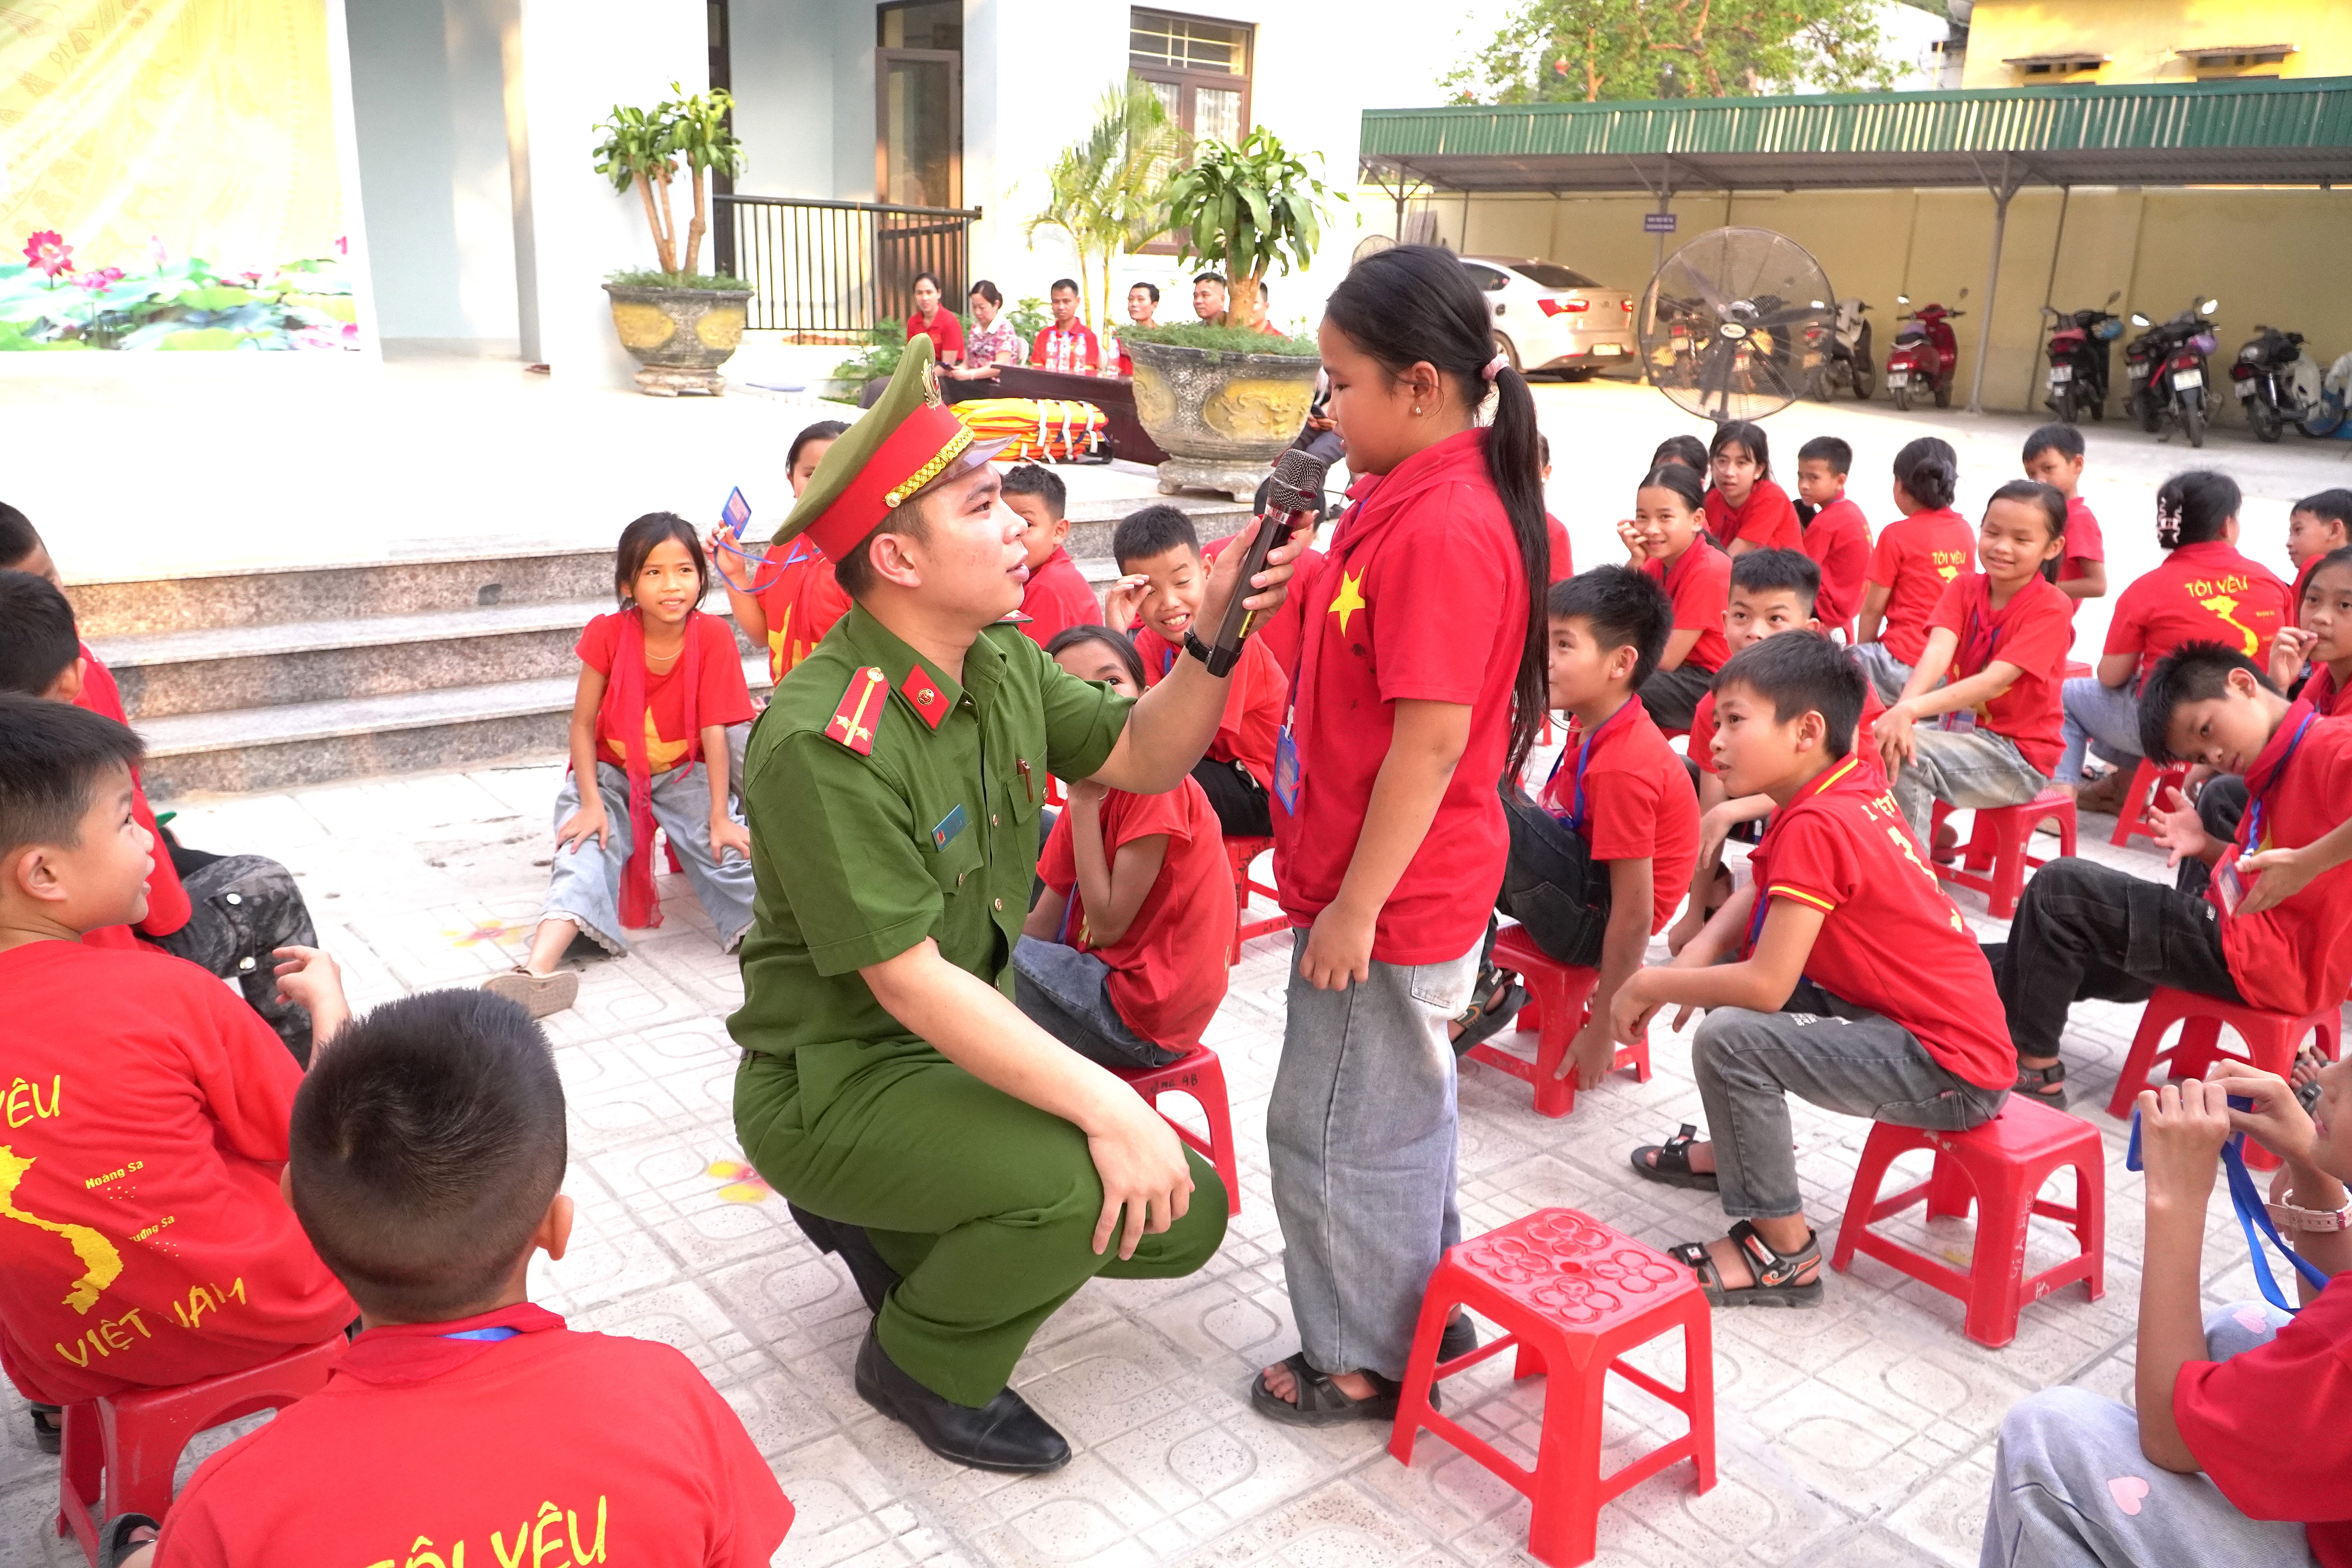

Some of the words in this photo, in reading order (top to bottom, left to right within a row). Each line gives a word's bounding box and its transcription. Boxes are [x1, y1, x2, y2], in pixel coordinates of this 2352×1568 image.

[1932, 550, 1948, 565] TÔI
[1950, 549, 1966, 565] YÊU
[2184, 579, 2213, 598] TÔI
[2216, 574, 2248, 594] YÊU
[85, 1168, 125, 1190] Hoàng
[127, 1160, 144, 1173] Sa
[161, 1215, 175, 1228] Sa
[55, 1308, 152, 1367] VIỆT
[491, 1495, 607, 1568] YÊU
